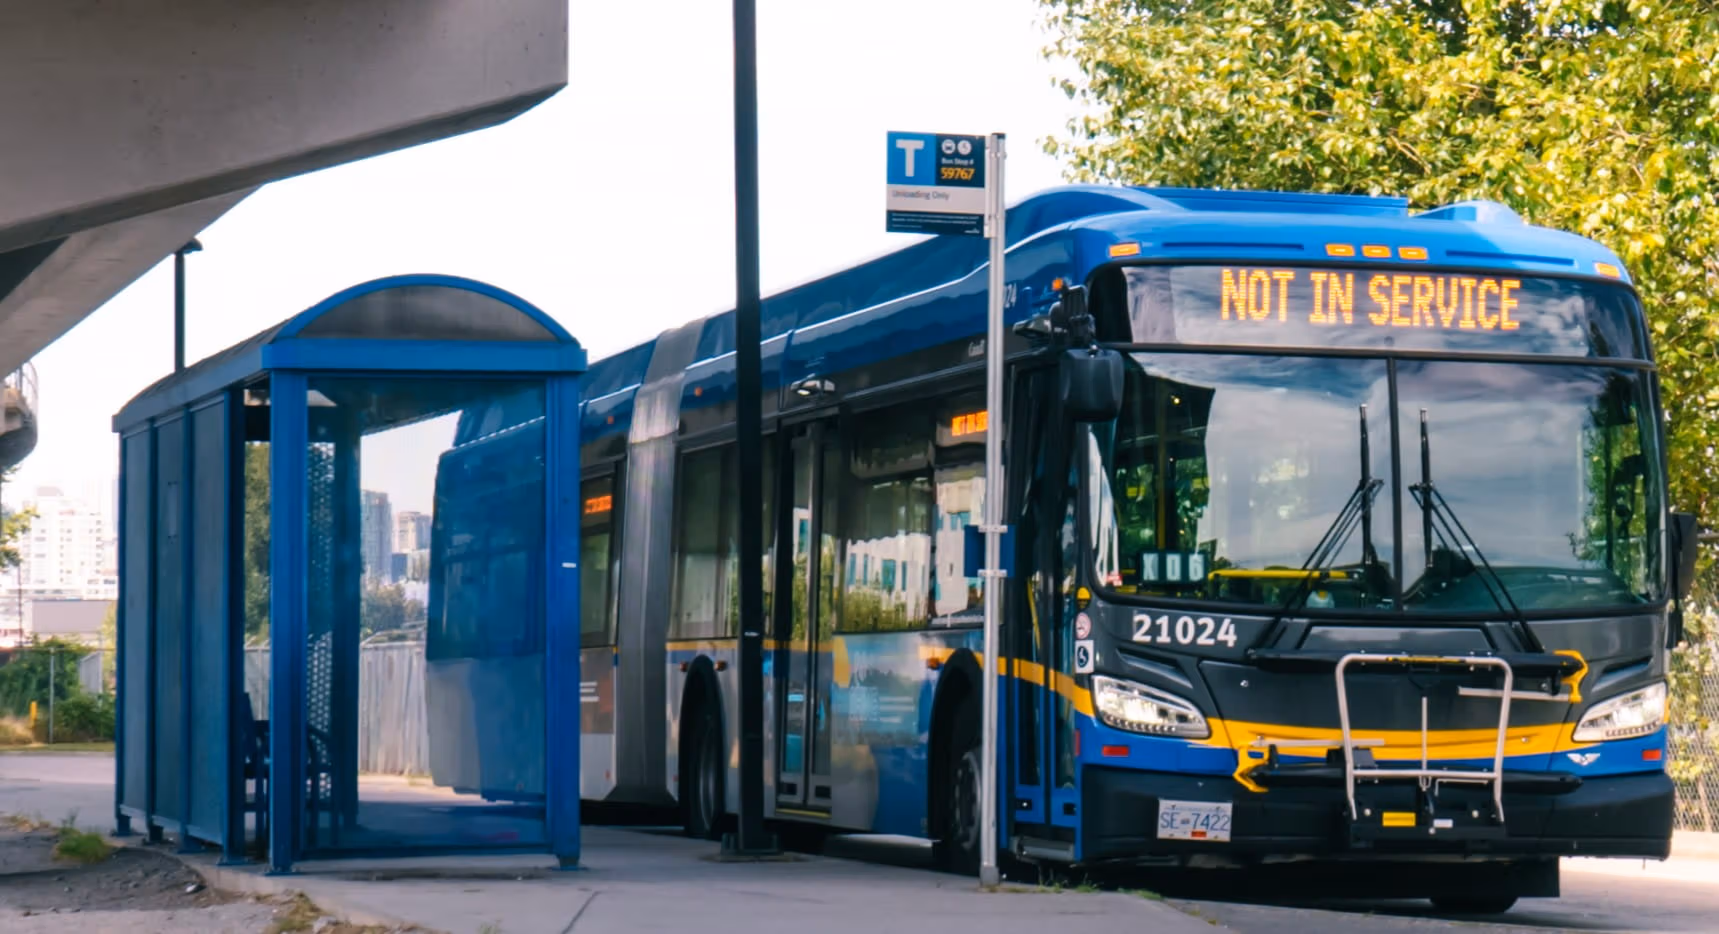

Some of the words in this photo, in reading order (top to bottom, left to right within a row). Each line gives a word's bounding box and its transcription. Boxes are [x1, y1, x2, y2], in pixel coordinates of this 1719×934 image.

[896, 139, 924, 177] T
[941, 168, 975, 180] 59767
[892, 190, 930, 200] Unloading
[932, 191, 949, 200] Only
[1221, 268, 1295, 322] NOT
[1309, 272, 1354, 325] IN
[1368, 274, 1521, 330] SERVICE
[1132, 613, 1238, 648] 21024
